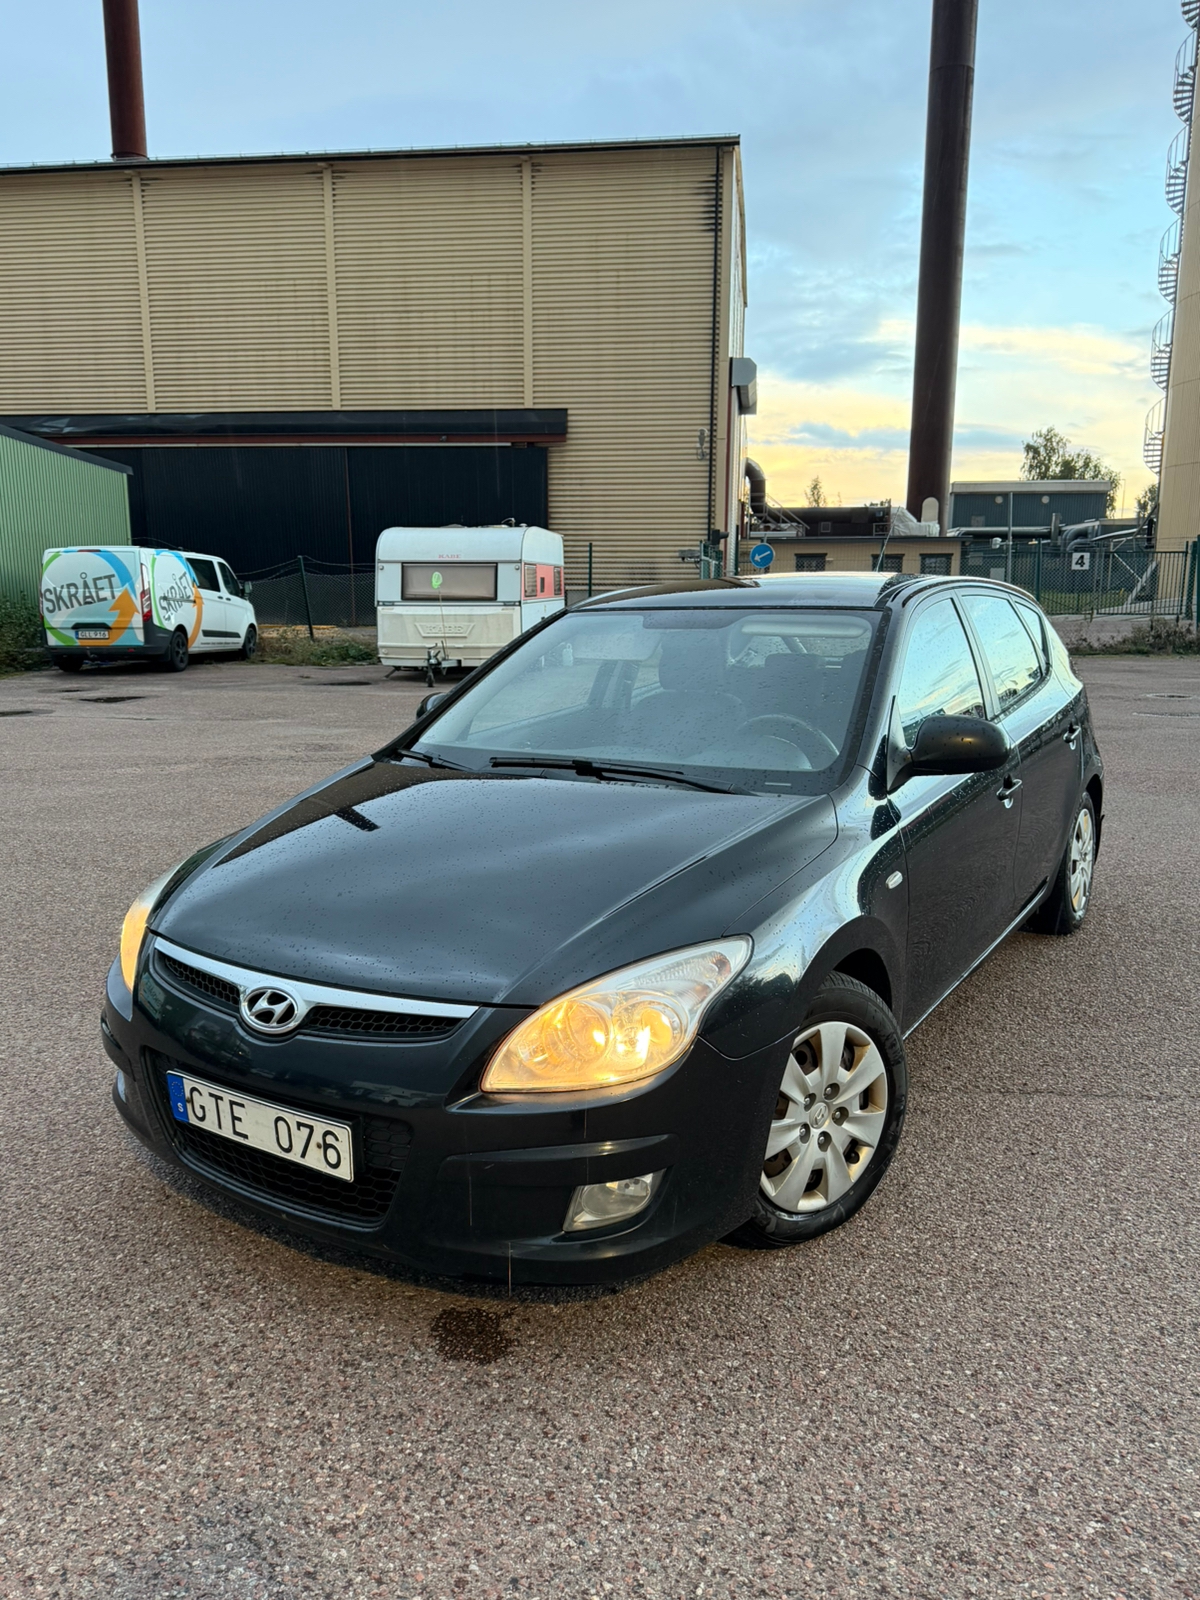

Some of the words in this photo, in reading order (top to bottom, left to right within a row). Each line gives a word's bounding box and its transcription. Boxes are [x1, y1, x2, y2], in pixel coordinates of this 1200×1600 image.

[1074, 554, 1086, 568] 4
[43, 572, 116, 614] SKRÅET
[159, 571, 194, 621] SKRÅET
[177, 1103, 184, 1112] S
[189, 1086, 249, 1140] GTE
[274, 1116, 341, 1169] 076
